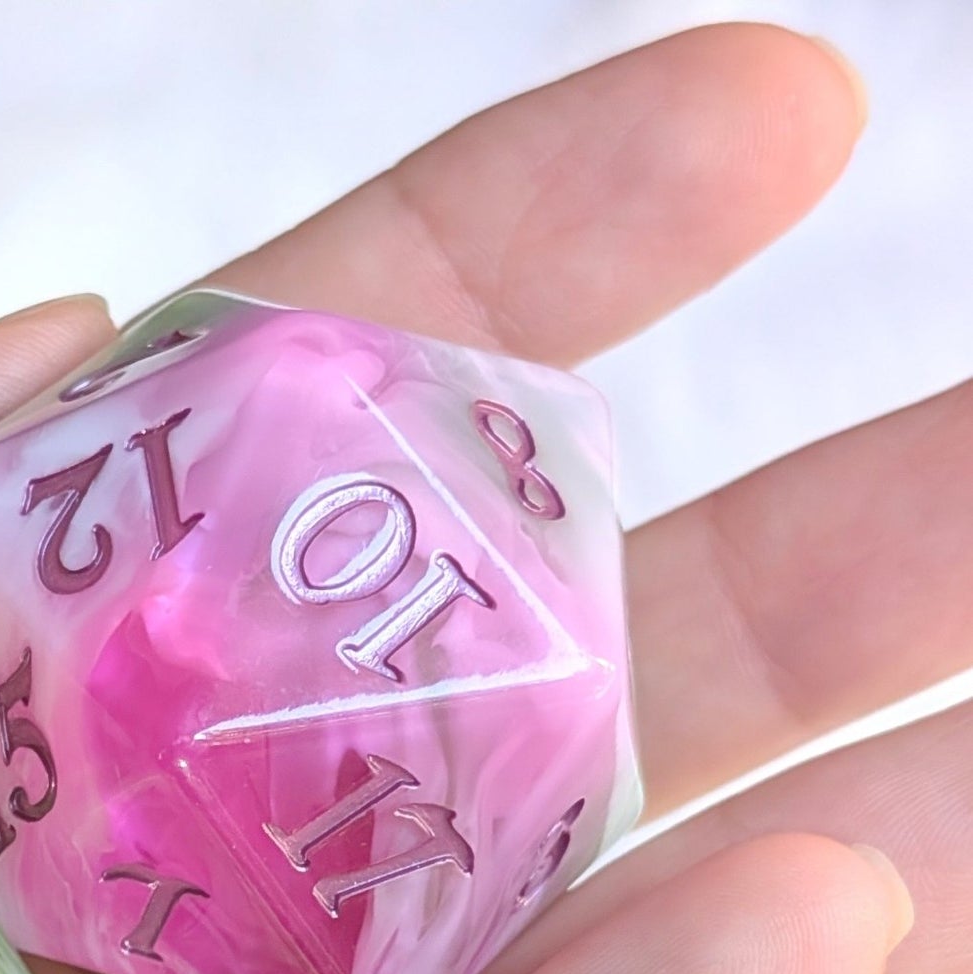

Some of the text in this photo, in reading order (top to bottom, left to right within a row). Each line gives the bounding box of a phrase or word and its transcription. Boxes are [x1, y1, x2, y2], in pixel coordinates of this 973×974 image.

[20, 407, 206, 595] 12
[473, 399, 566, 520] 8
[270, 471, 497, 683] 10
[100, 863, 211, 962] 7
[262, 754, 475, 918] 17
